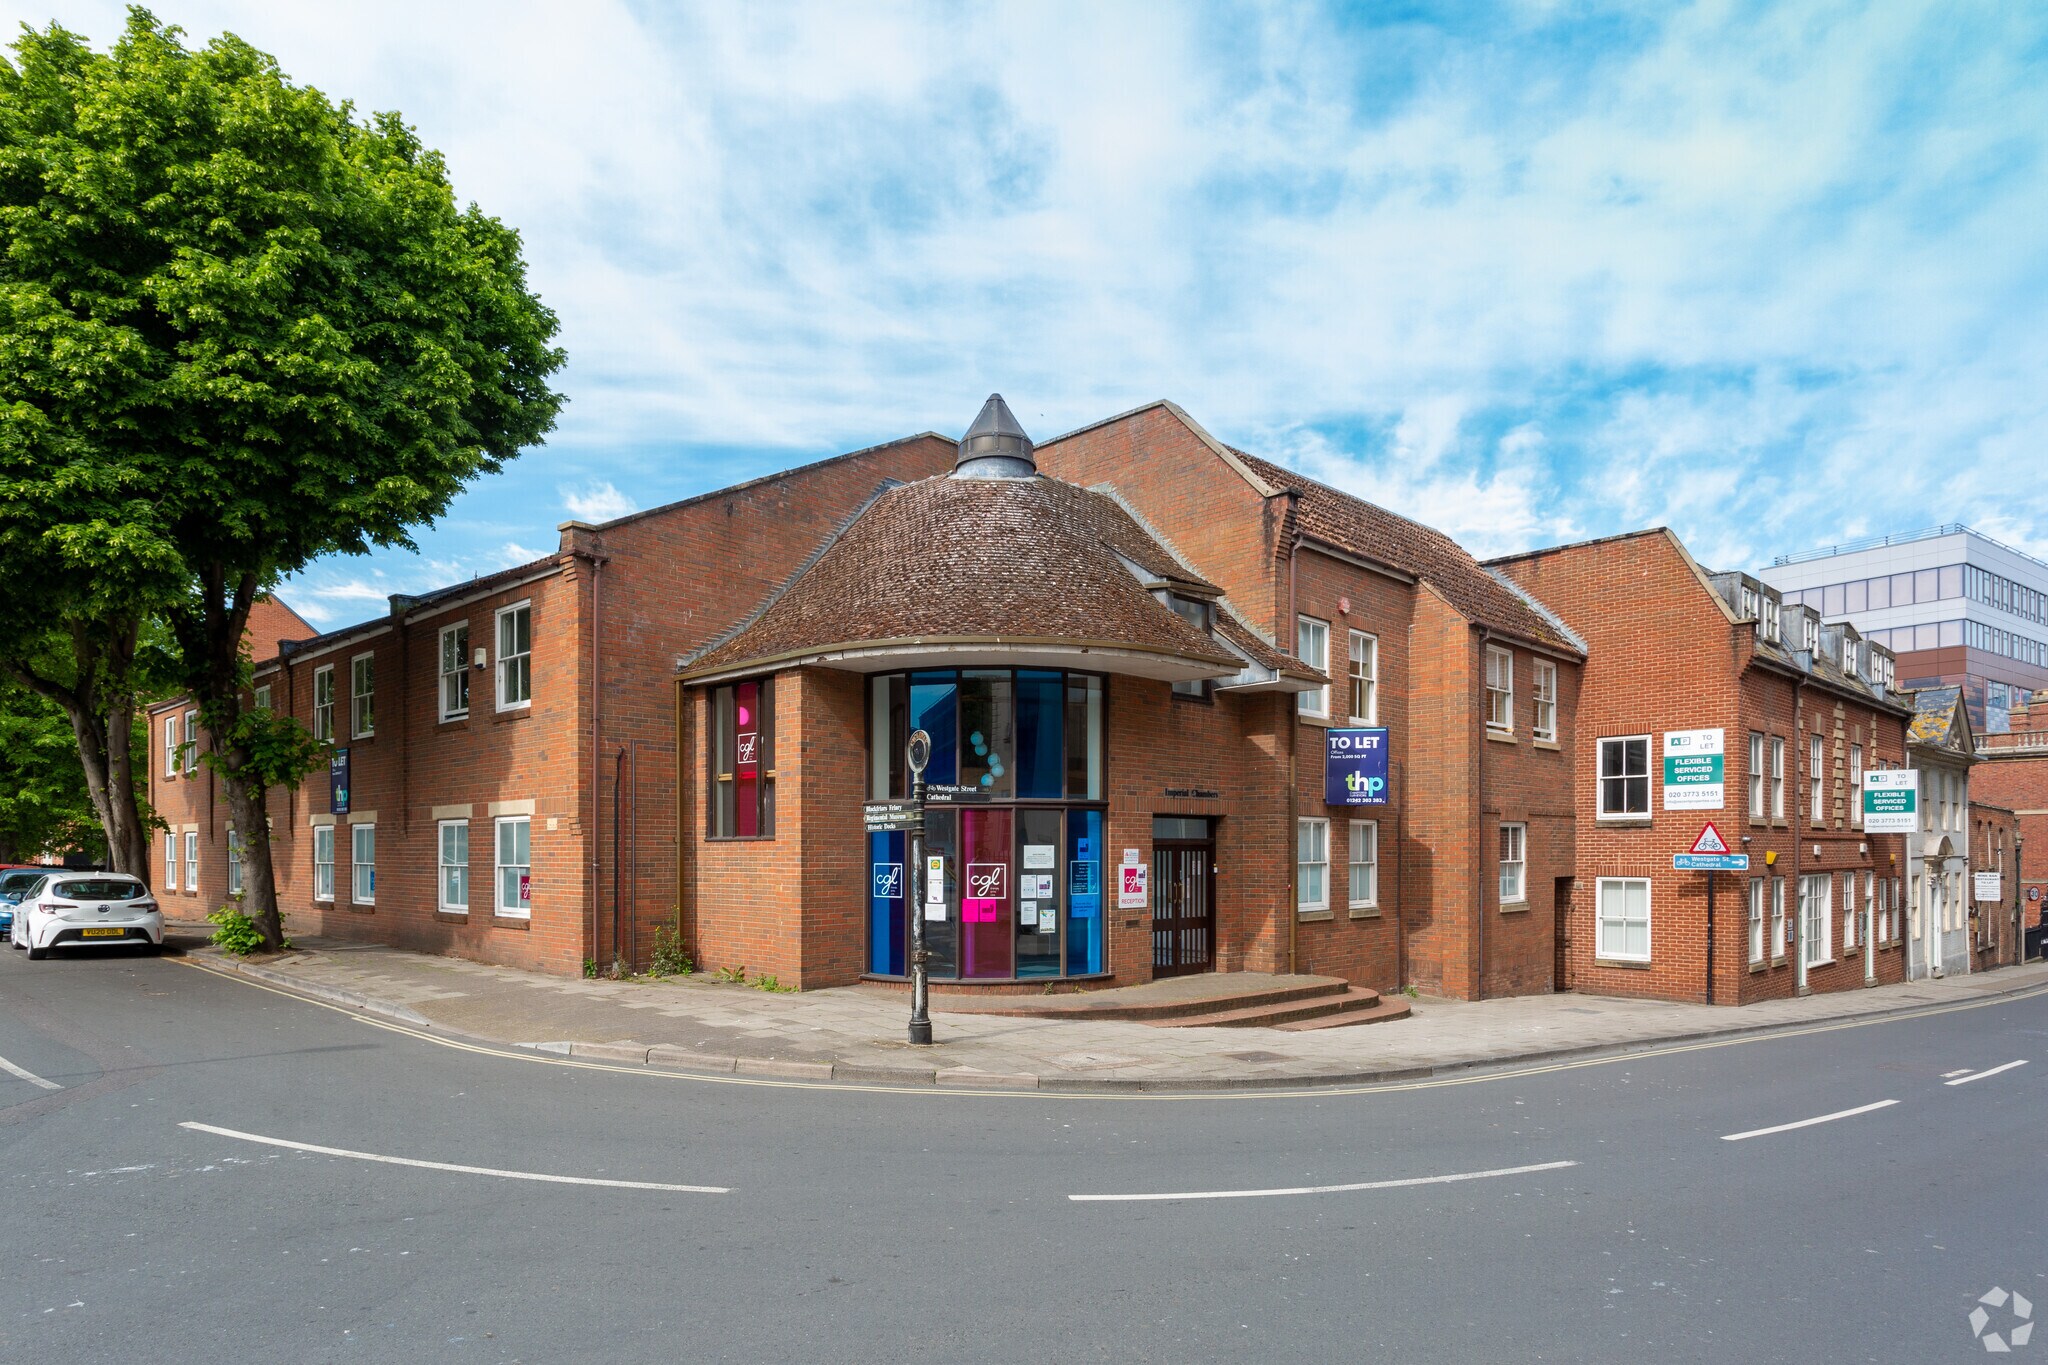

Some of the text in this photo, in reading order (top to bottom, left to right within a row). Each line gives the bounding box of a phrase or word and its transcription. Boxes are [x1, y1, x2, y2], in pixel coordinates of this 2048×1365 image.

[740, 736, 754, 761] cgl
[1330, 736, 1380, 749] TO LET
[338, 756, 346, 766] LET
[1345, 770, 1384, 797] thp
[336, 784, 348, 806] thp
[522, 882, 530, 898] cg
[876, 867, 898, 895] cgl
[970, 867, 1000, 896] cgl
[1125, 876, 1137, 892] cg
